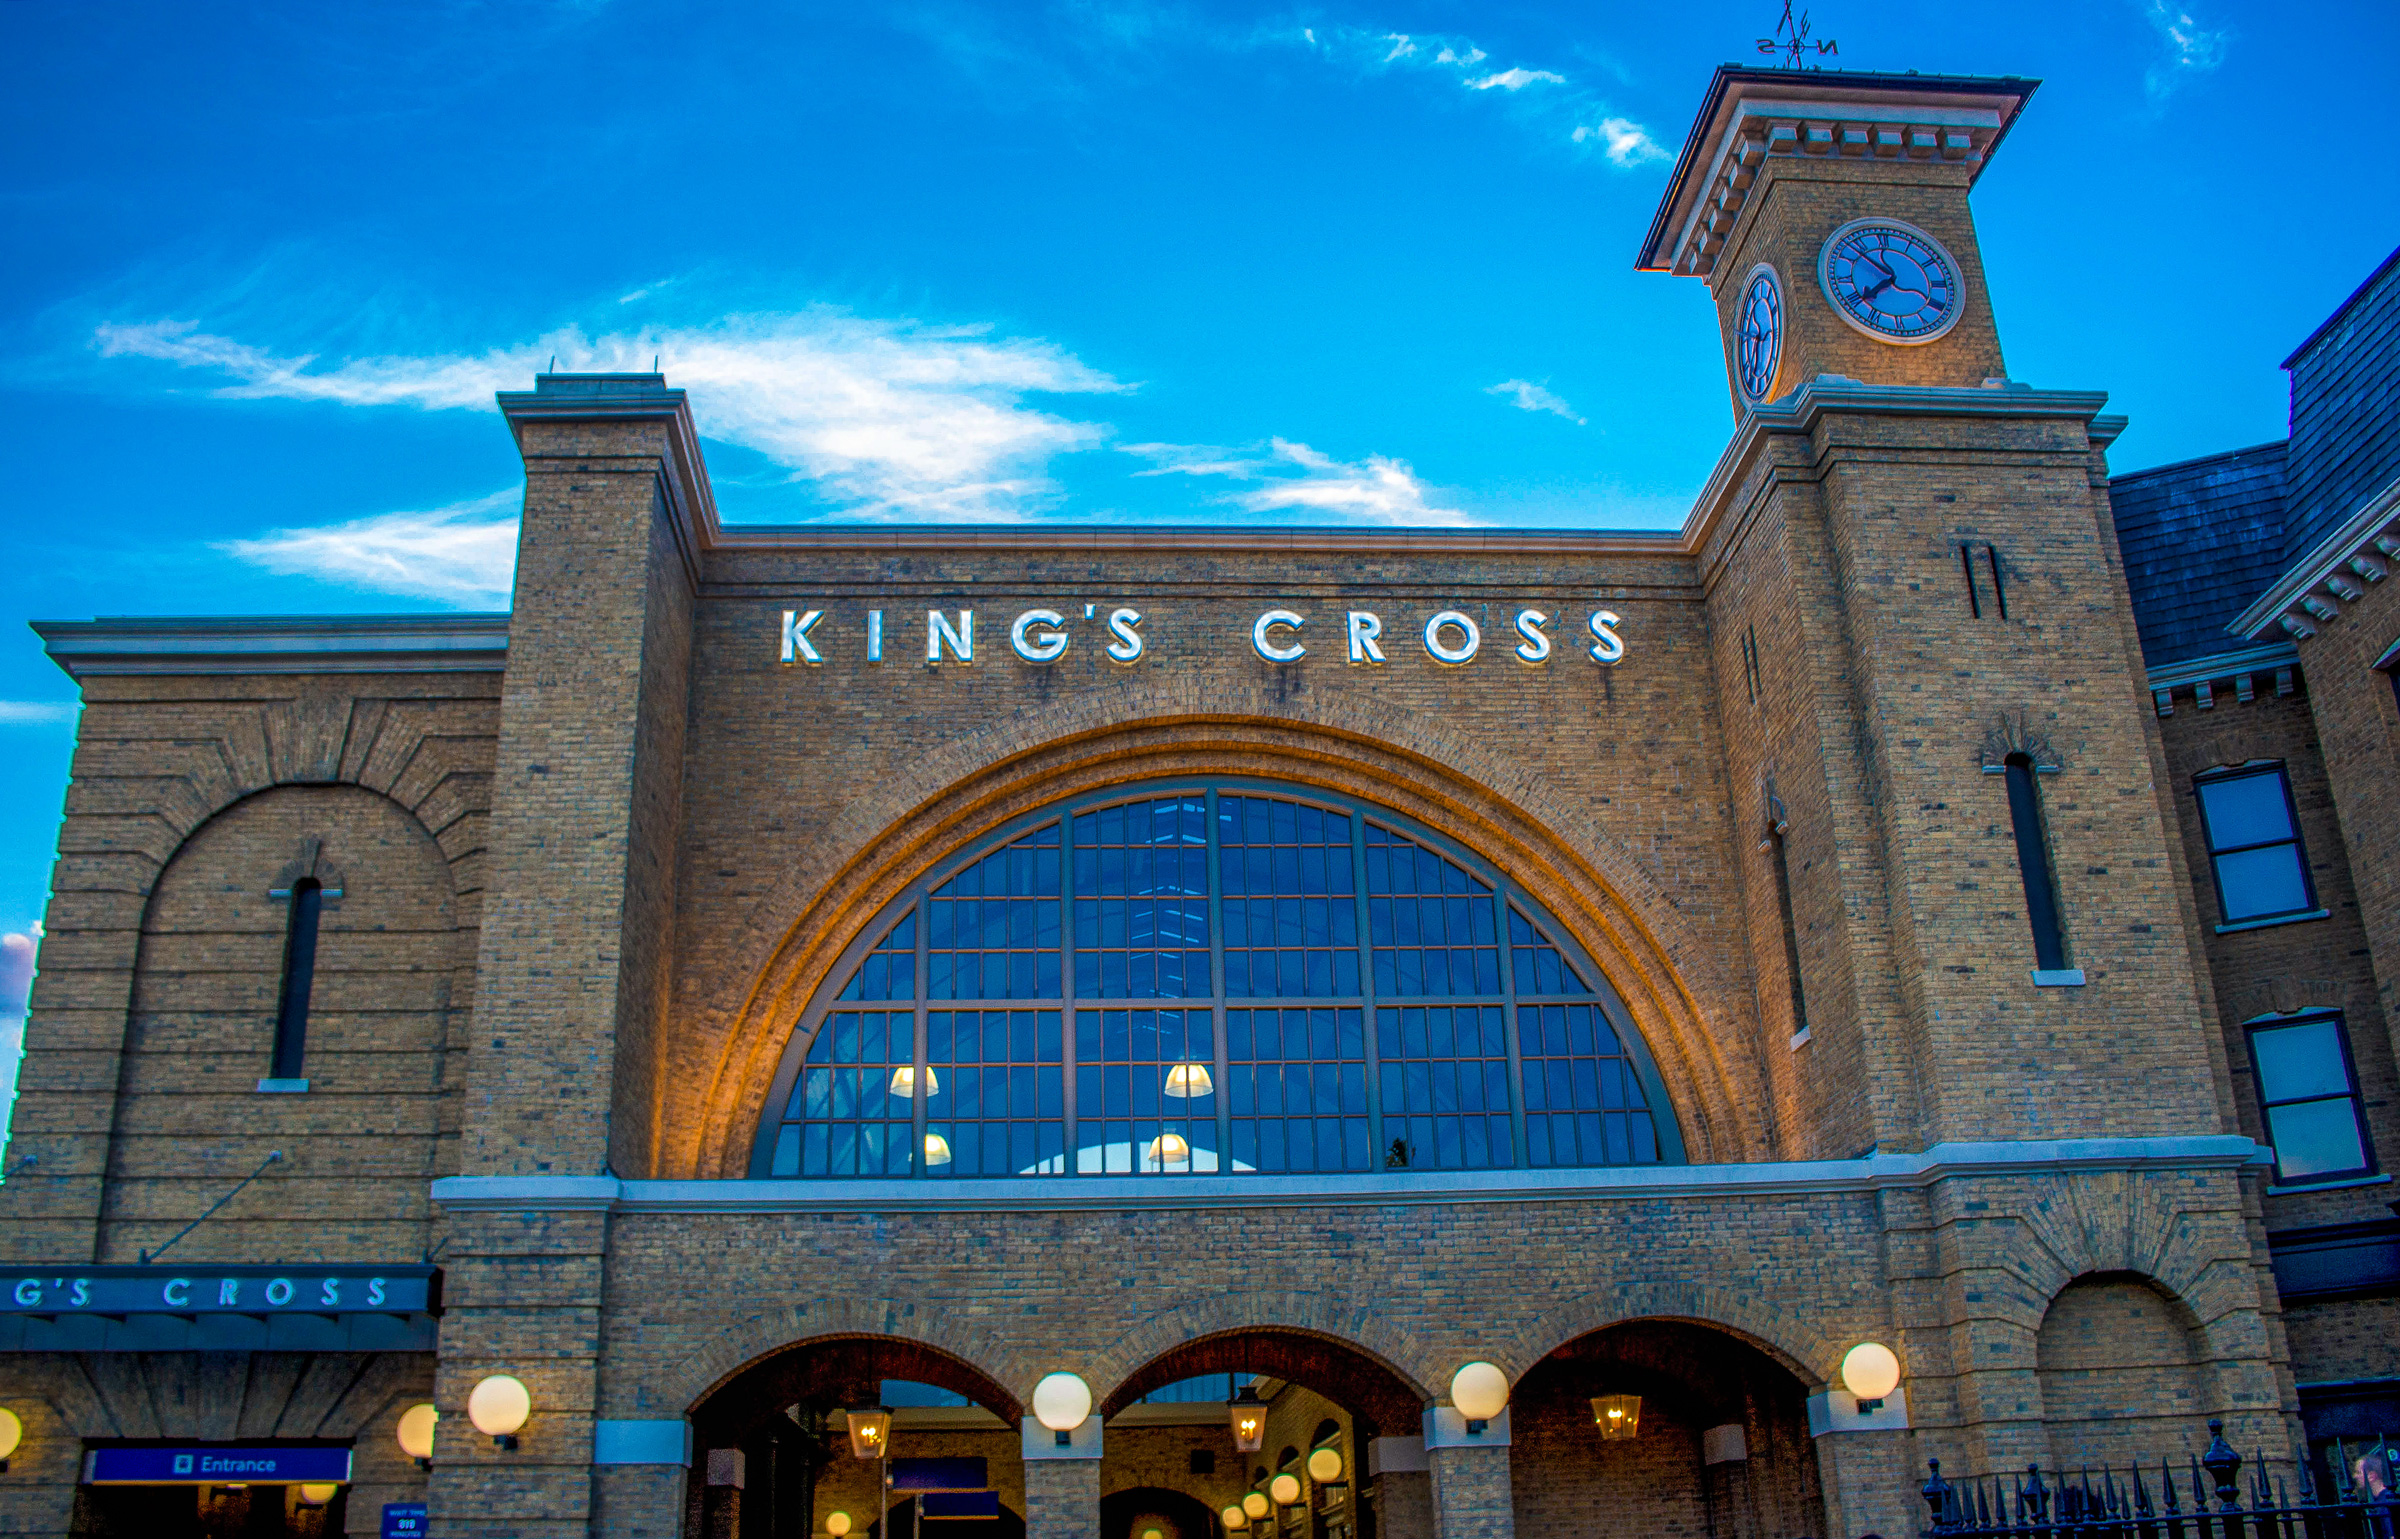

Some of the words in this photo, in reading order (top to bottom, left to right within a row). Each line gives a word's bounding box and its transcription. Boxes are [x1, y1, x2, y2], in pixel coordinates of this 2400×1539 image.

[780, 603, 1144, 663] KING'S
[1252, 609, 1624, 664] CROSS
[163, 1278, 387, 1306] CROSS
[201, 1456, 276, 1473] Entrance
